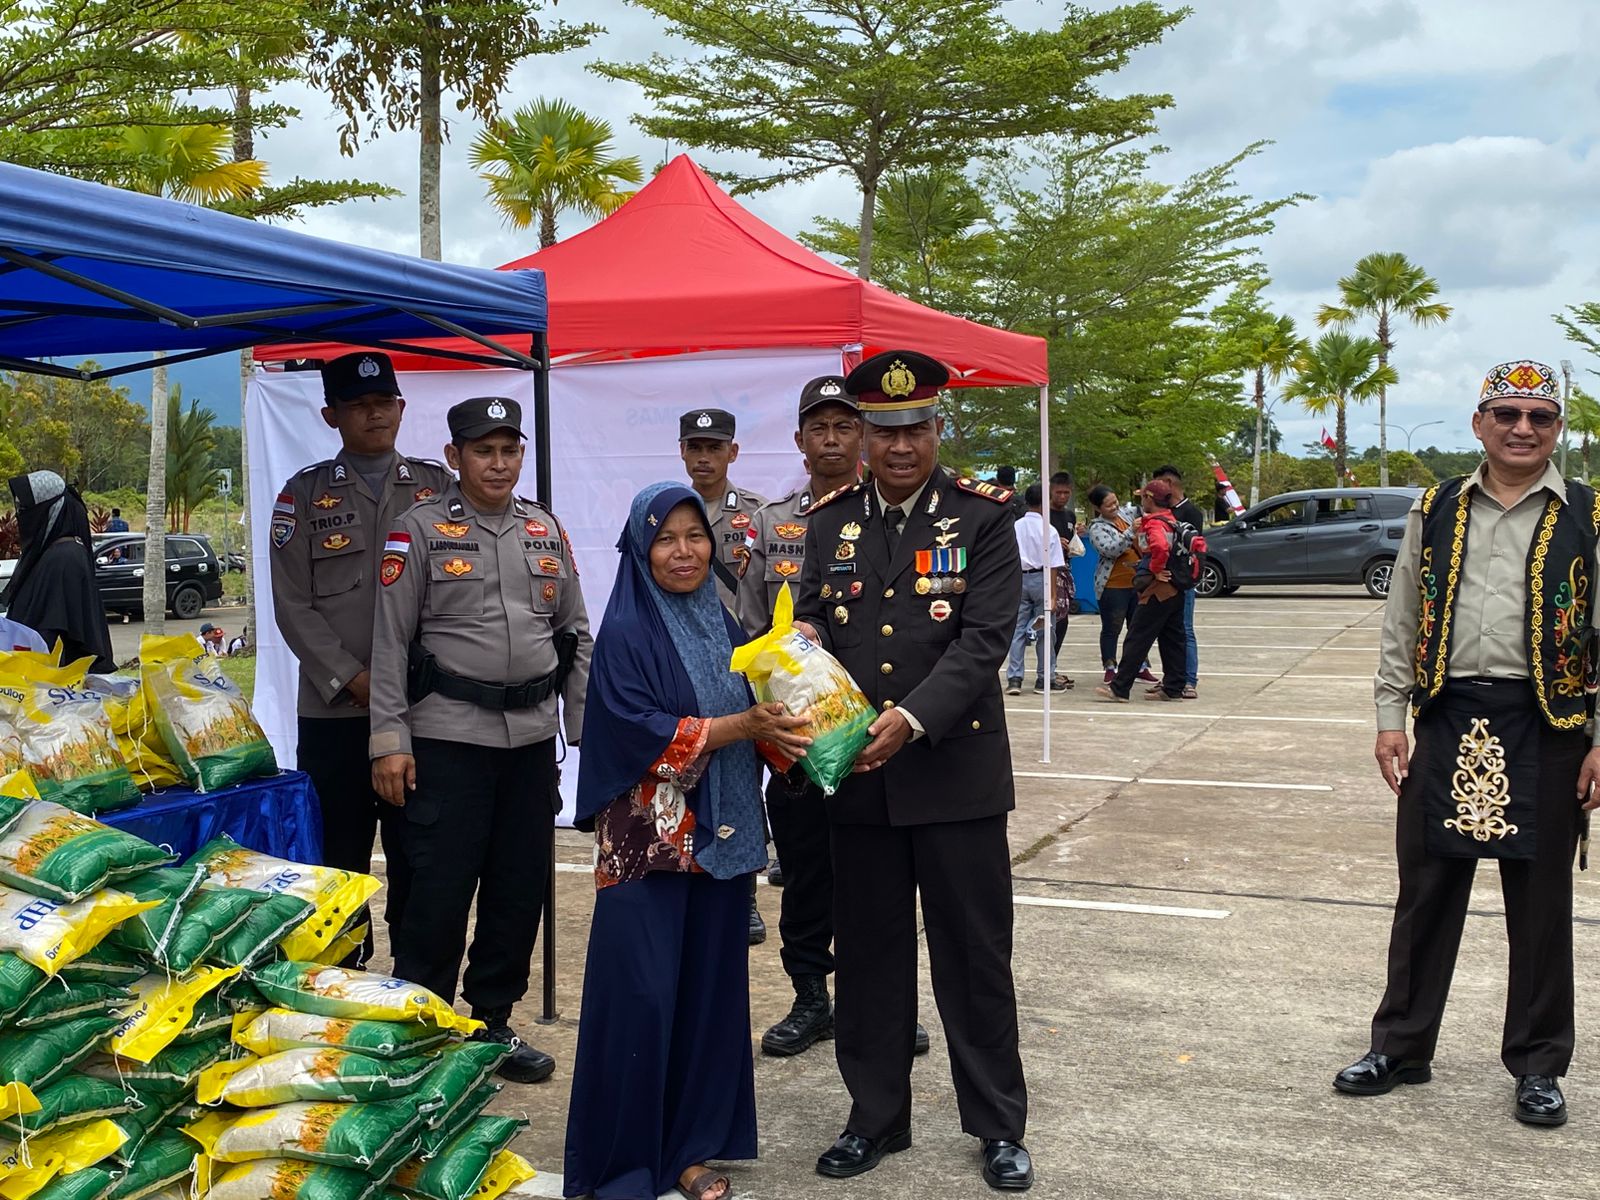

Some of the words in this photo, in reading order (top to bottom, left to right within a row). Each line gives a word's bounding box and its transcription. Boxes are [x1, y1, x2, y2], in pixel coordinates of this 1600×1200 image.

[310, 513, 355, 531] TRIO.P
[524, 540, 560, 552] POLRI
[768, 543, 804, 555] MASN
